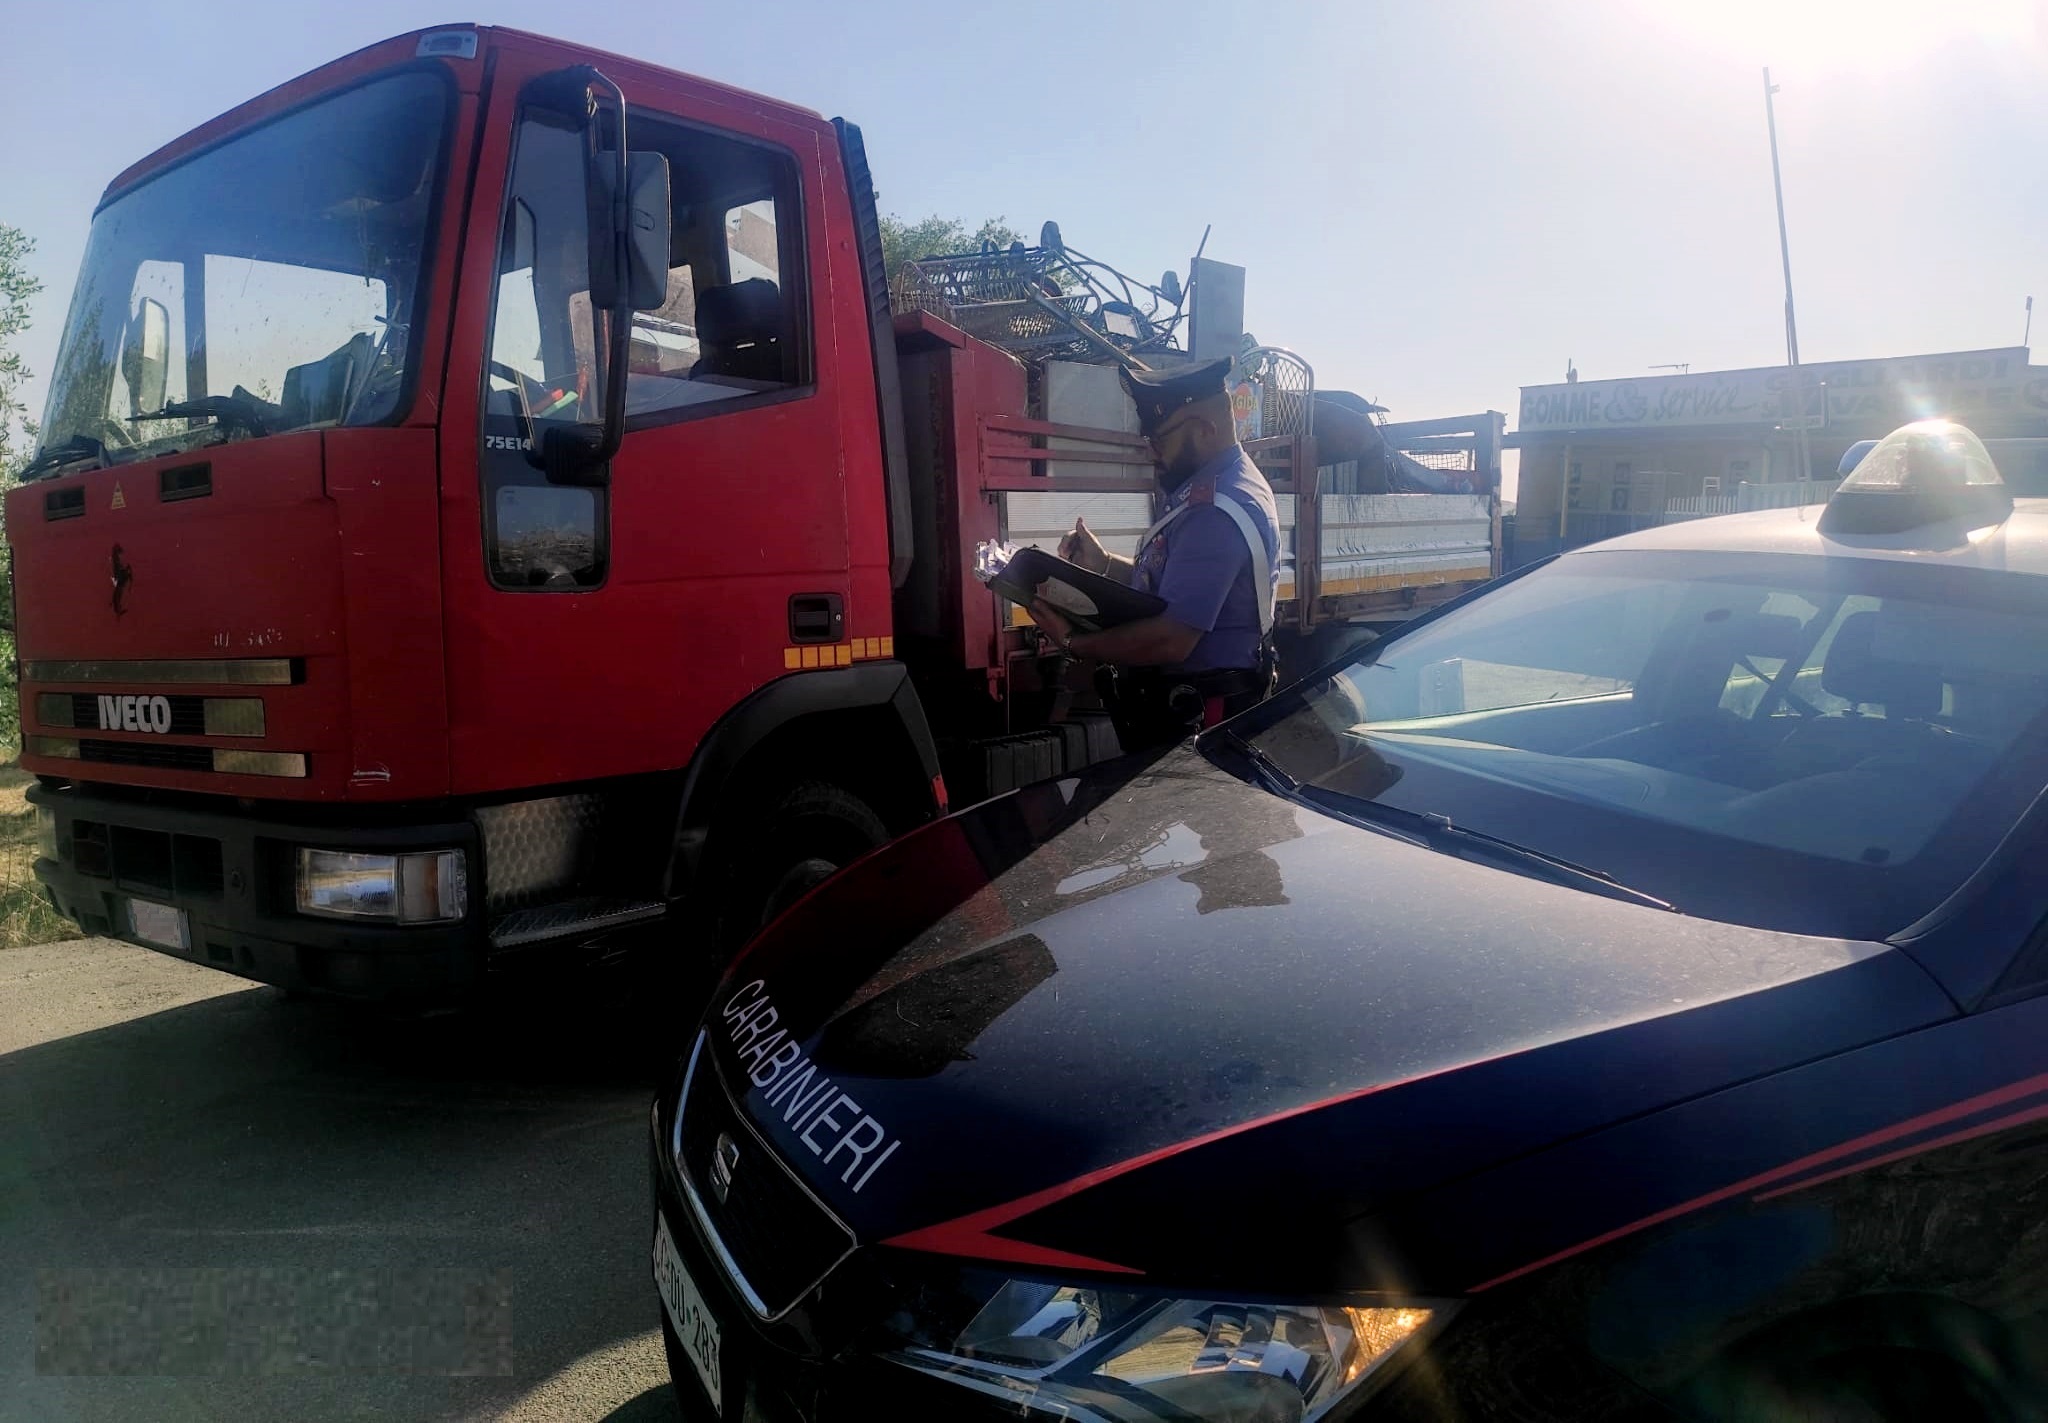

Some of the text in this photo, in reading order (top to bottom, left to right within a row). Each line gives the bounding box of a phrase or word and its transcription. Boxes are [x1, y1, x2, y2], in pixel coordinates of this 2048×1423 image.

[1521, 391, 1600, 425] GOMME
[485, 435, 532, 451] 75E14
[97, 694, 172, 734] IVECO
[722, 979, 902, 1194] CARABINIERI
